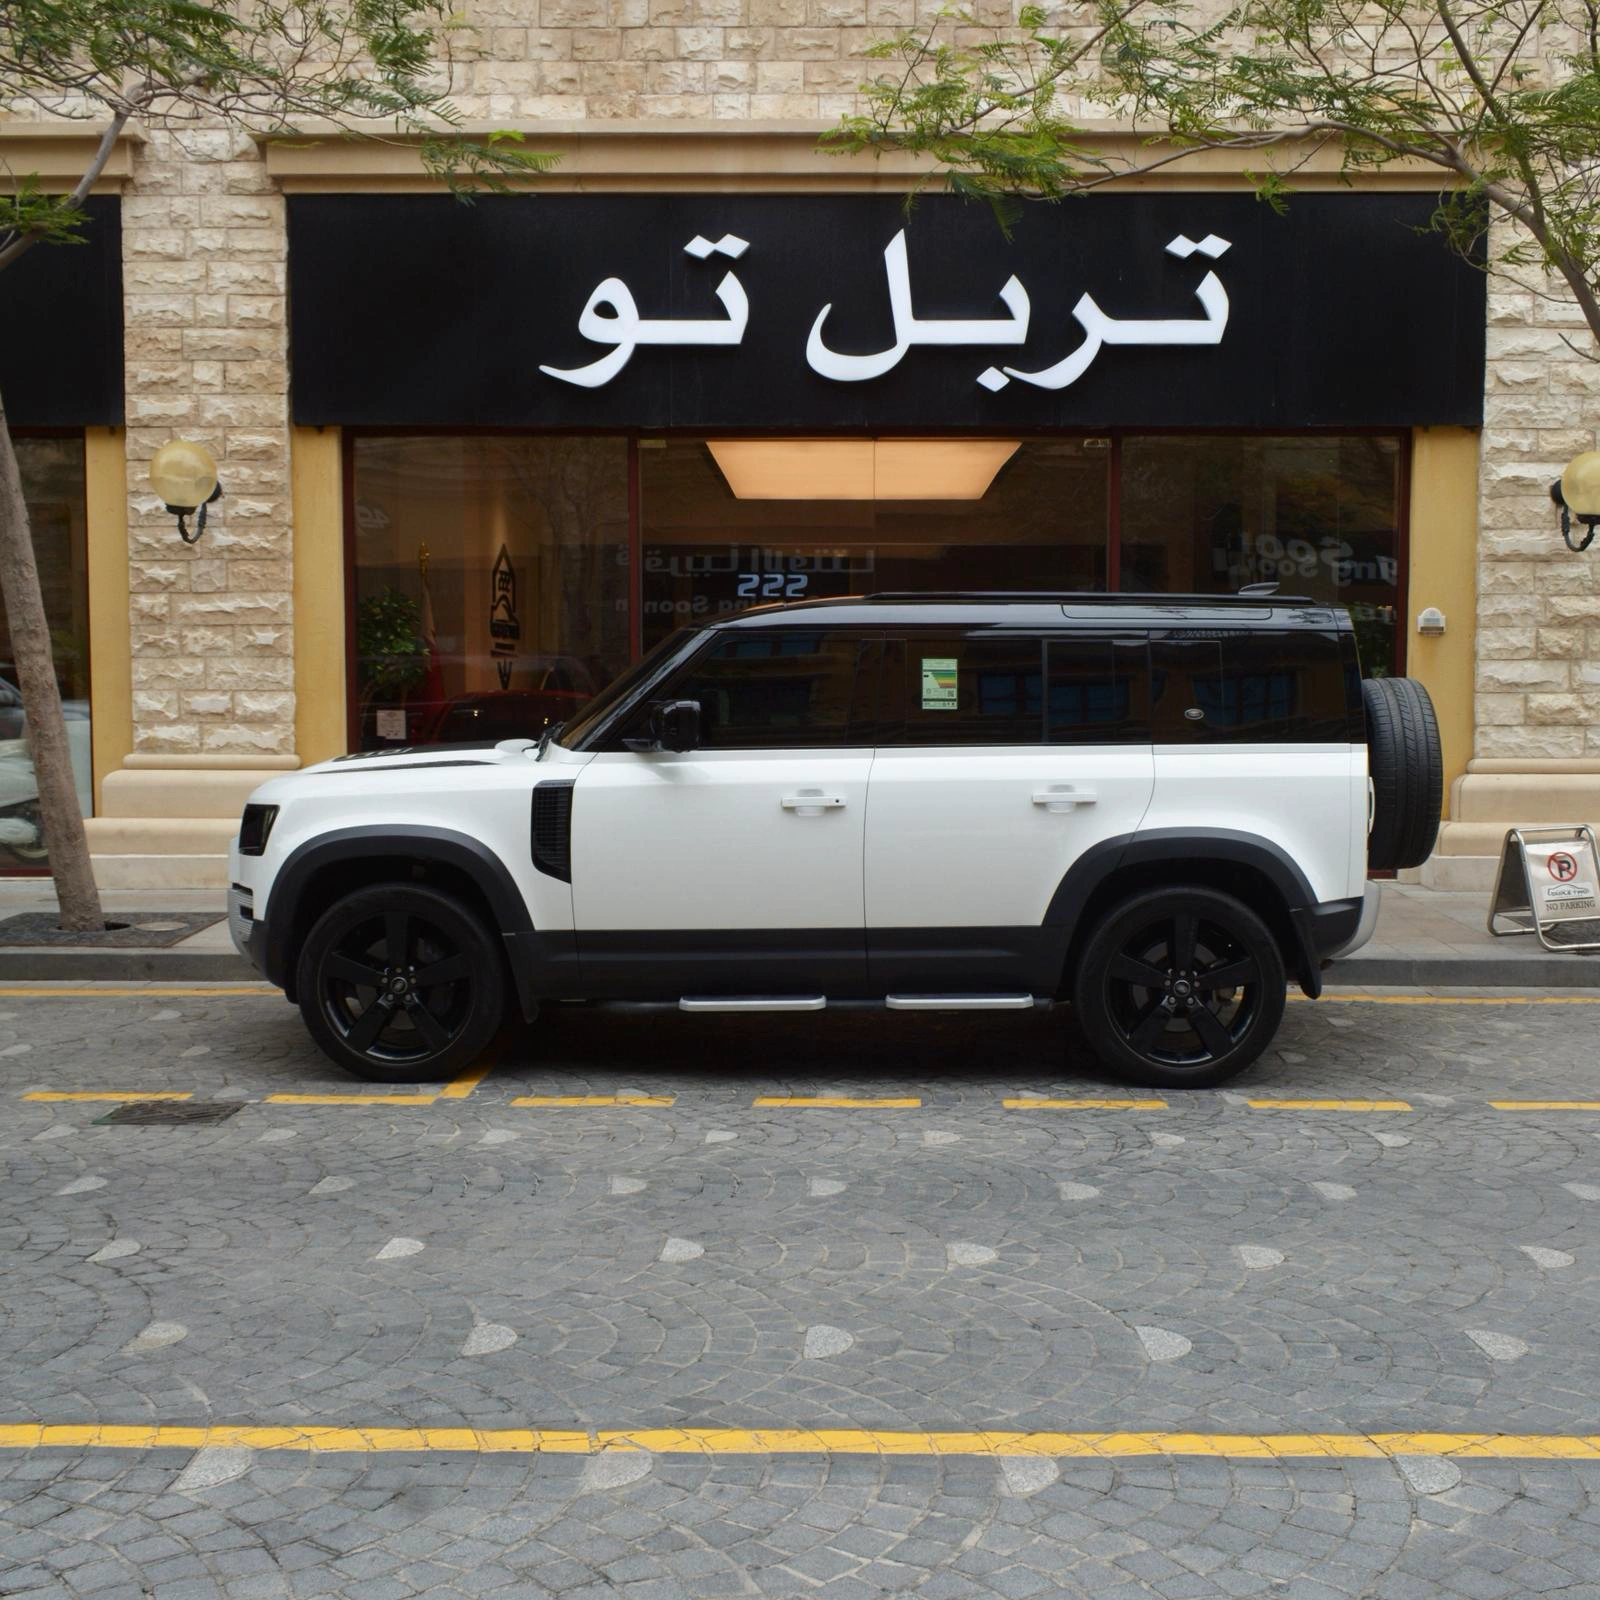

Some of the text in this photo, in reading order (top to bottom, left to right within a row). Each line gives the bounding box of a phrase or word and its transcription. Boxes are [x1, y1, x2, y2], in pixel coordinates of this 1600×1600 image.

[539, 234, 749, 387] تو
[1546, 900, 1596, 912] NO PARKING
